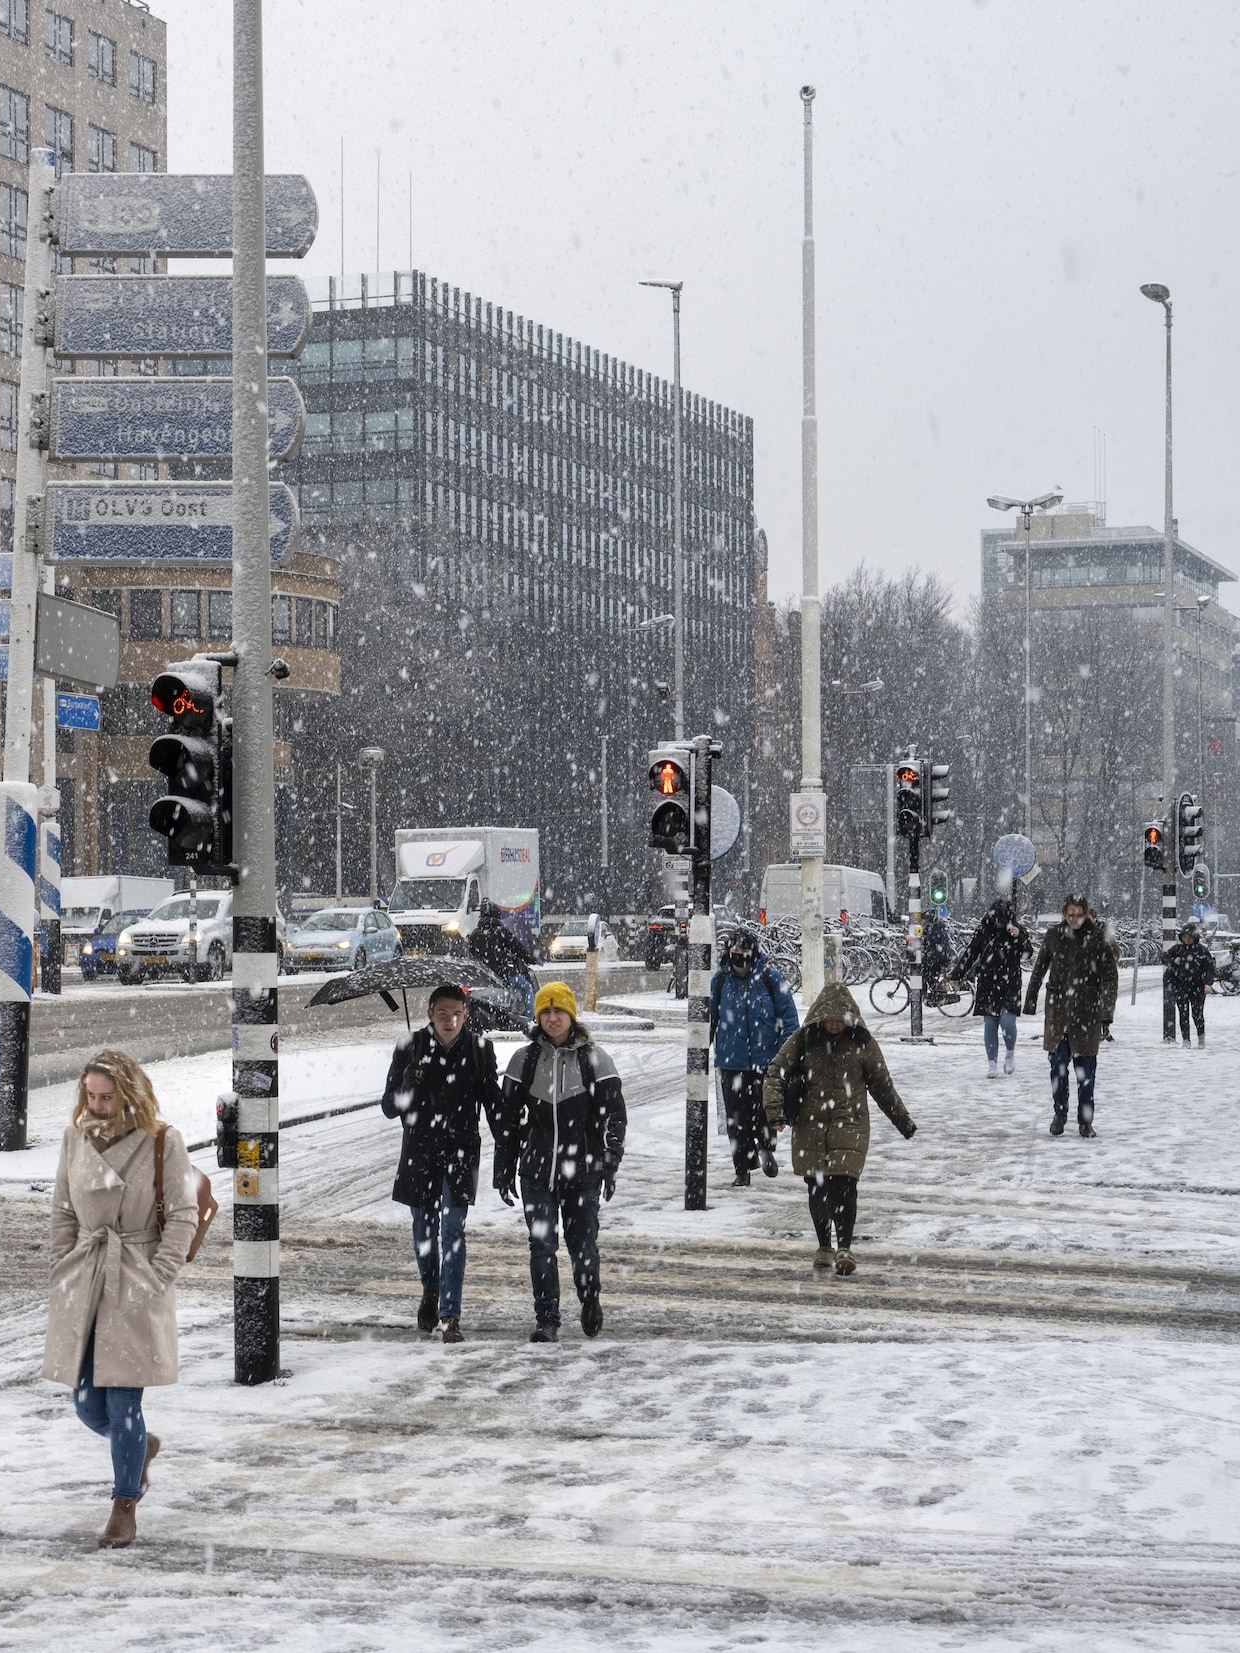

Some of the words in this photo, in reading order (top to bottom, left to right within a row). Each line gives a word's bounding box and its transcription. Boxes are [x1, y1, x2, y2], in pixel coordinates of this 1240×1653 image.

[117, 424, 233, 449] Havengeb
[95, 499, 152, 517] OLVG
[161, 500, 208, 517] Oost
[185, 852, 199, 860] 241
